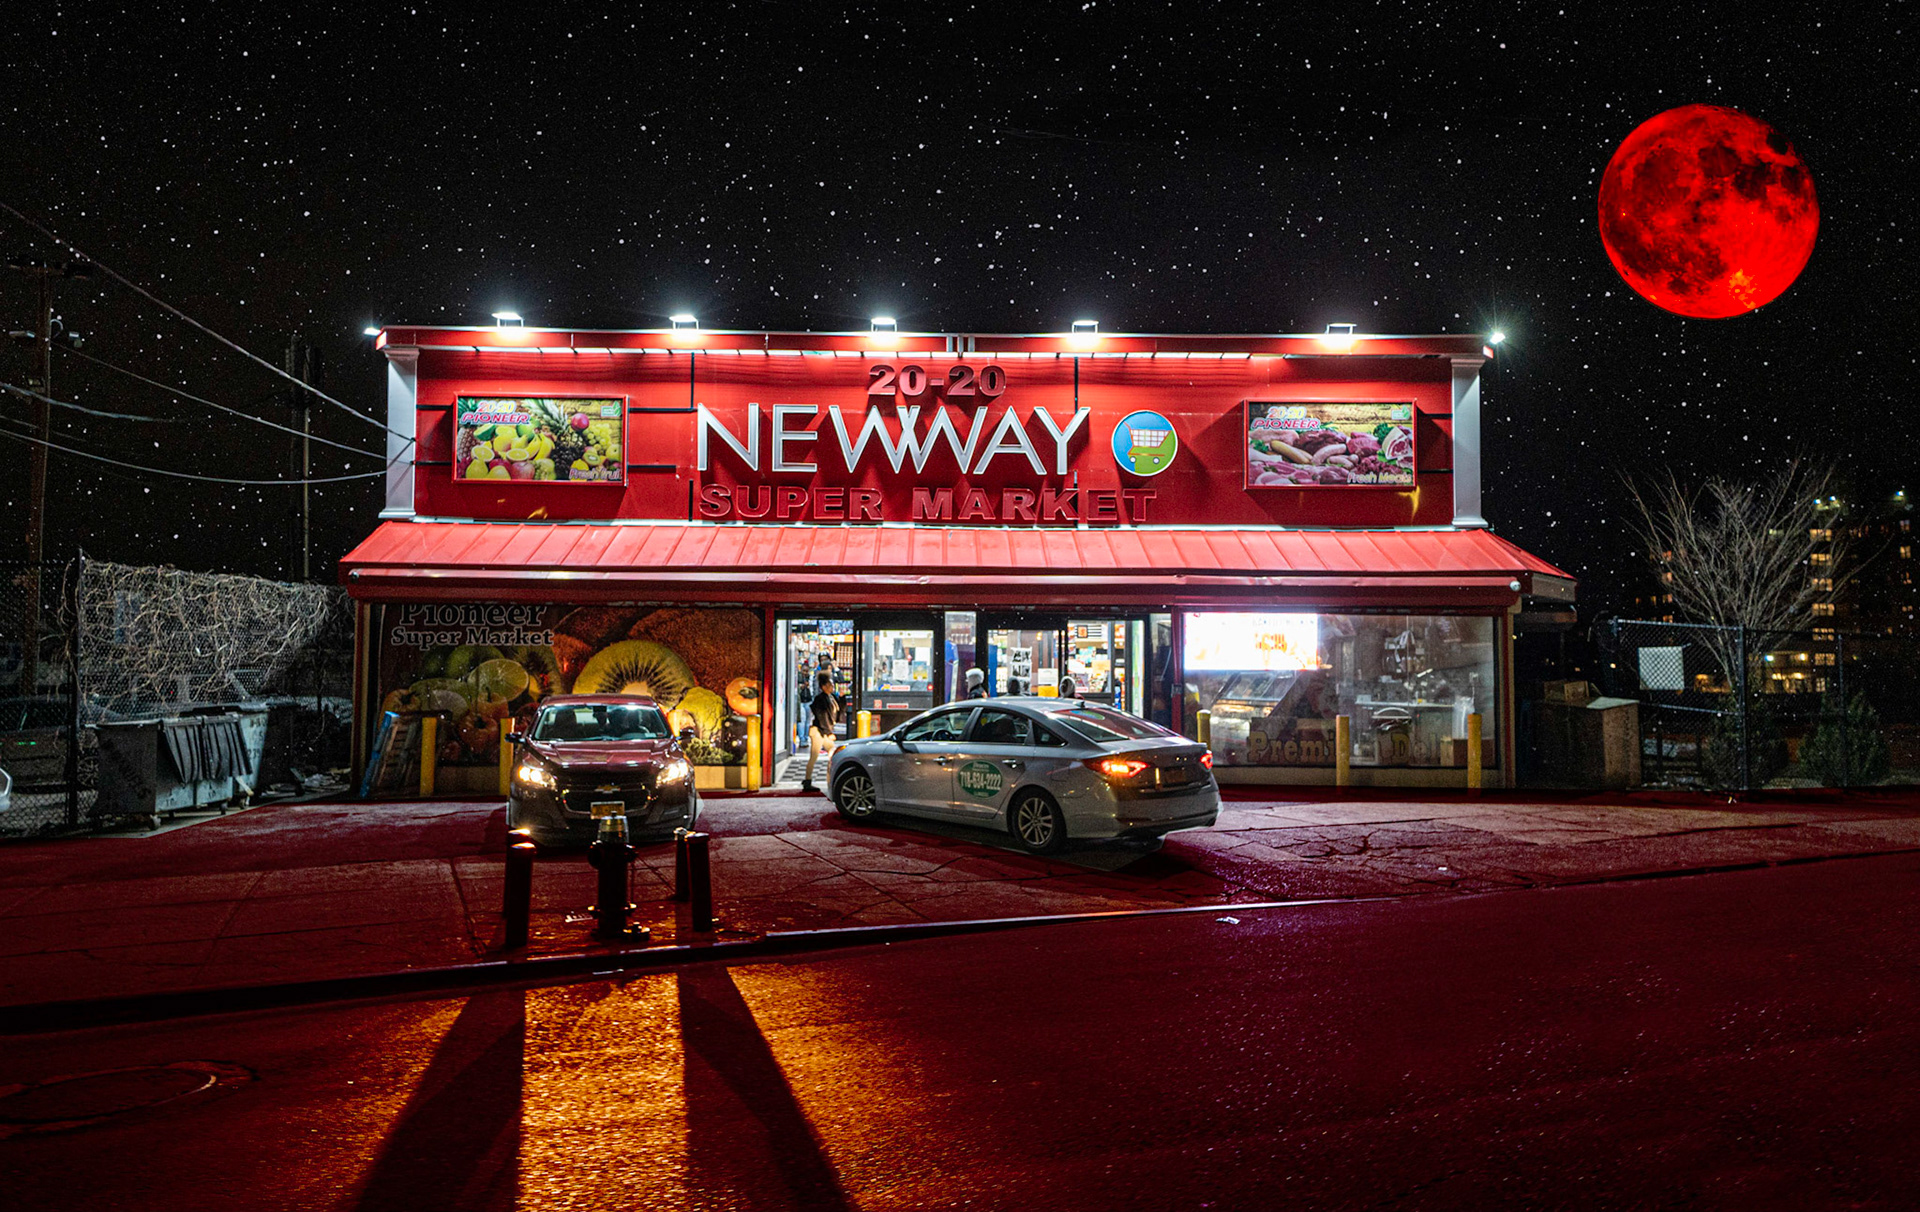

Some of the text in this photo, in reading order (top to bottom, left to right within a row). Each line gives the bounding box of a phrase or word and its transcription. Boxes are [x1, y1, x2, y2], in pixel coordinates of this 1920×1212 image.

[867, 365, 1006, 397] 20-20
[461, 412, 530, 424] PIONEER
[1252, 419, 1320, 430] PIONEER
[697, 402, 1091, 476] NEWWAY
[1346, 471, 1378, 484] Fresh
[699, 483, 1157, 521] SUPER MARKET
[399, 603, 547, 626] Pioneer
[391, 626, 554, 650] Super Market
